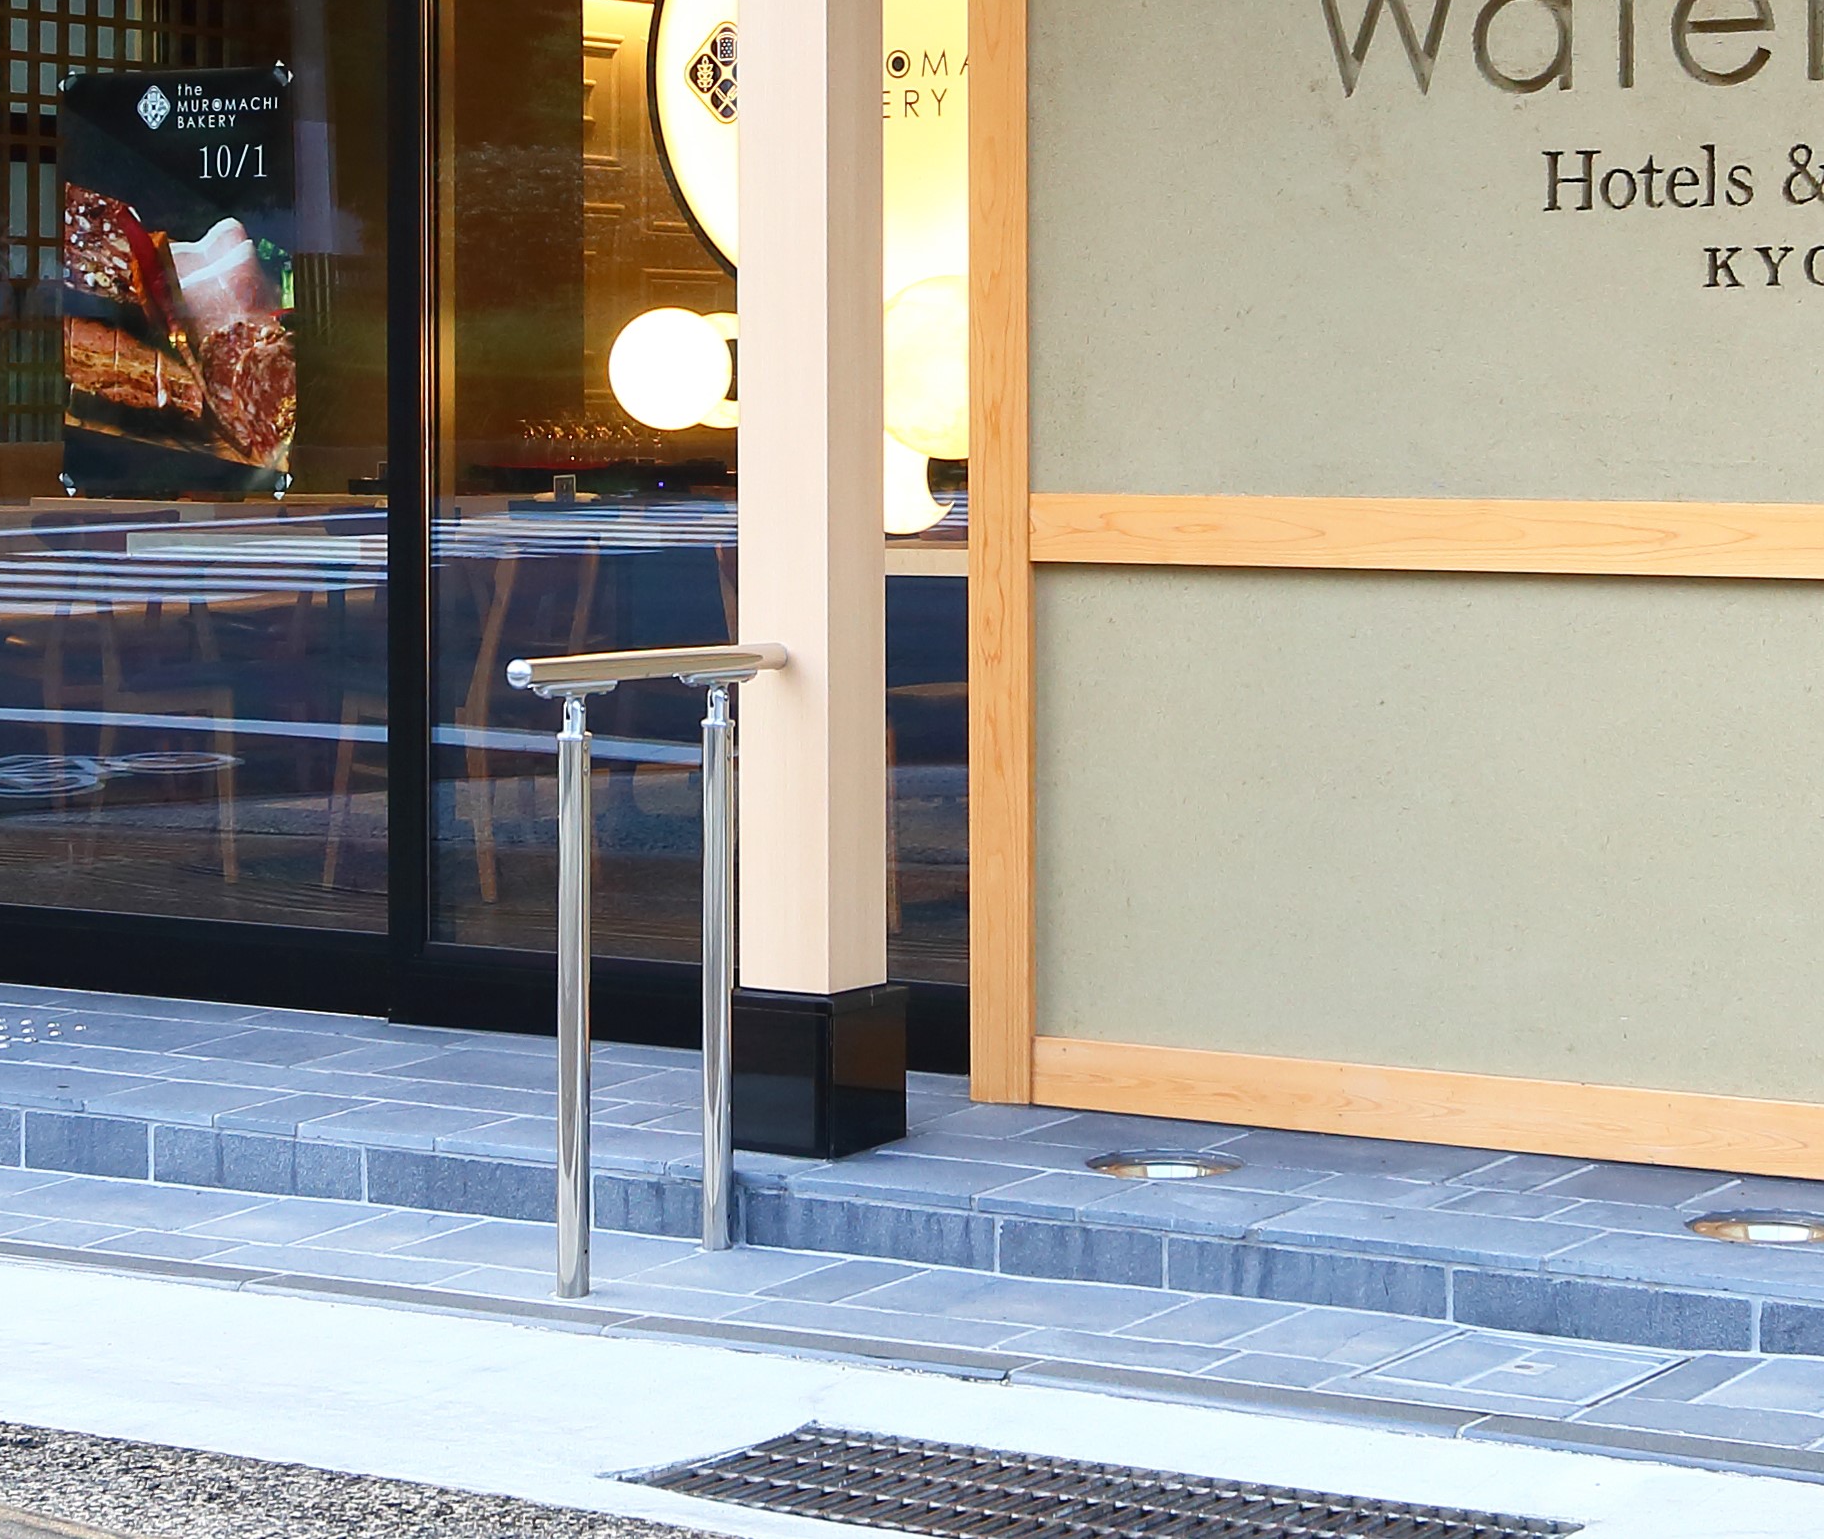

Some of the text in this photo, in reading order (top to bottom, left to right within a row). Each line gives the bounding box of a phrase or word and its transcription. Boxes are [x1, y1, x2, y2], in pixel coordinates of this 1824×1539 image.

[177, 83, 203, 96] the
[177, 97, 278, 112] MUROMACHI
[177, 114, 236, 129] BAKERY
[199, 143, 267, 179] 10/1
[1542, 145, 1754, 211] Hotels
